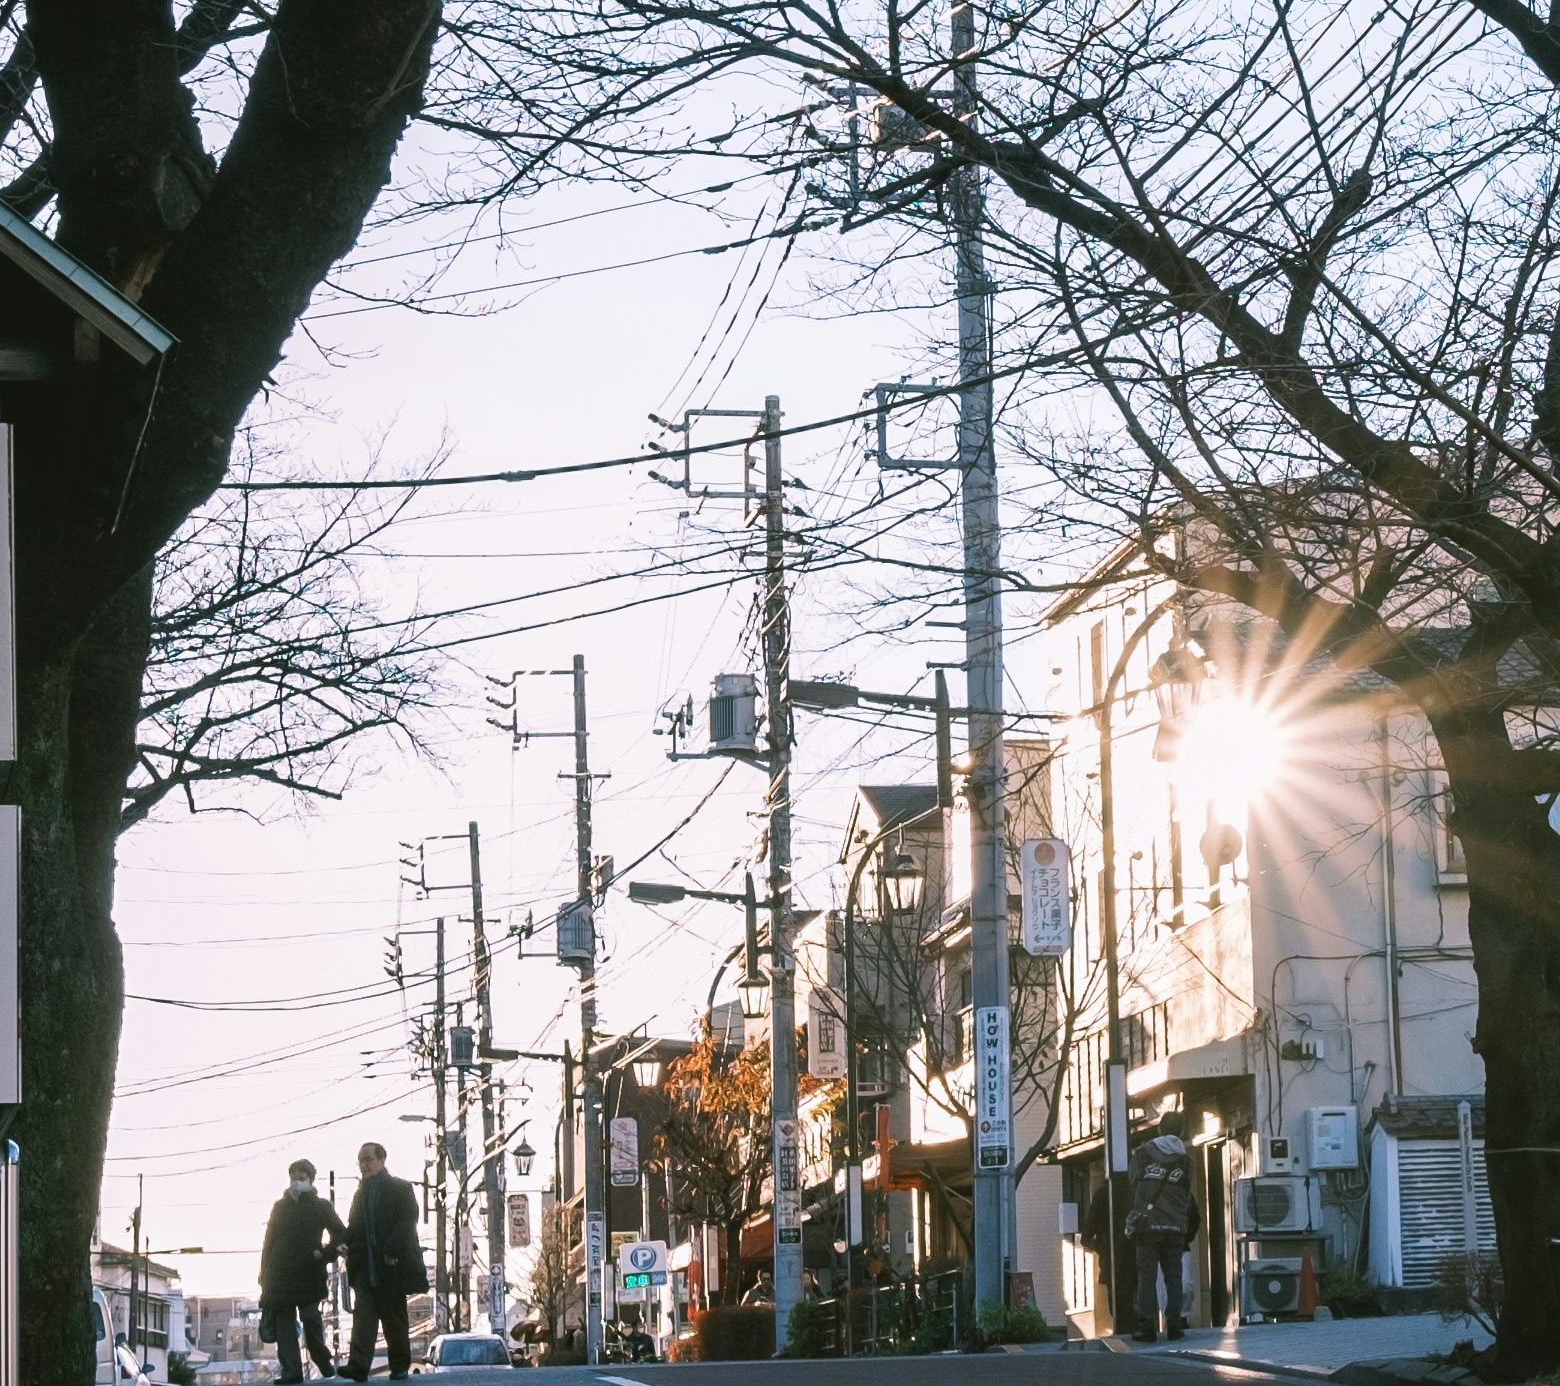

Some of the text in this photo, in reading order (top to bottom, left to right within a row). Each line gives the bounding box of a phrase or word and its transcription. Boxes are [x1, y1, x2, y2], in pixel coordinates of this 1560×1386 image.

[1038, 868, 1050, 931] チョコレート
[1049, 868, 1062, 931] フランス菓子
[986, 1012, 998, 1117] HOW HOUSE
